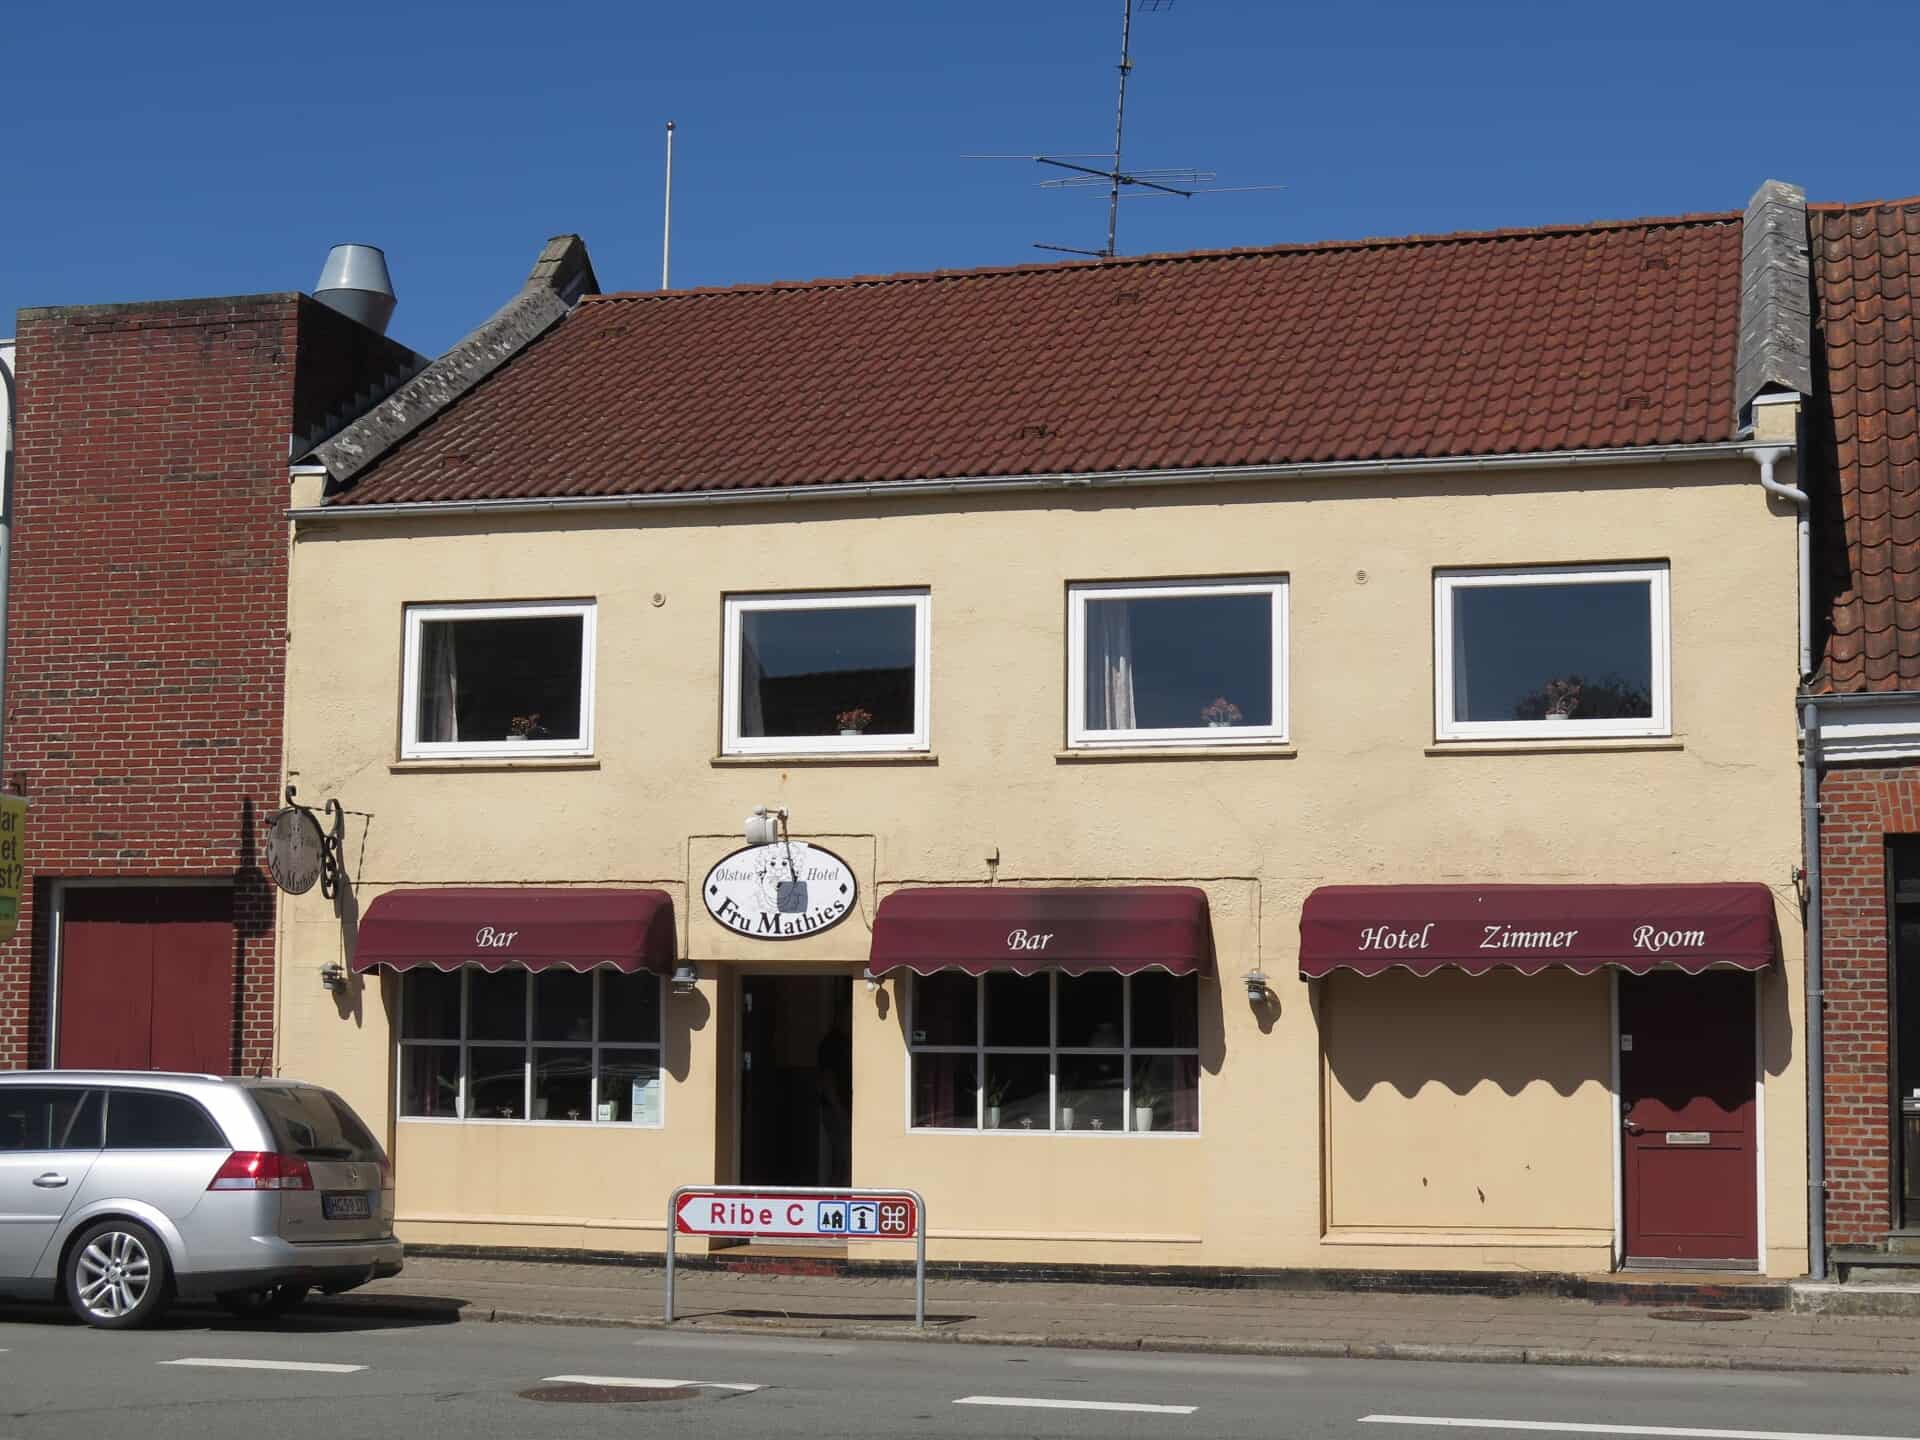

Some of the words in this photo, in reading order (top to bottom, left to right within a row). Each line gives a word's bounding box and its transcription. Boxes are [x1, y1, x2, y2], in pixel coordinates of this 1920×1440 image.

[0, 809, 18, 833] ar
[806, 867, 840, 881] Hotel
[715, 896, 751, 933] Fru
[757, 899, 846, 935] Mathies
[475, 926, 518, 948] Bar
[1007, 929, 1053, 951] Bar
[1358, 923, 1435, 951] Hotel
[1479, 924, 1579, 949] Zimmer
[1632, 924, 1705, 952] Room
[710, 1203, 773, 1225] Ribe
[786, 1203, 804, 1226] C
